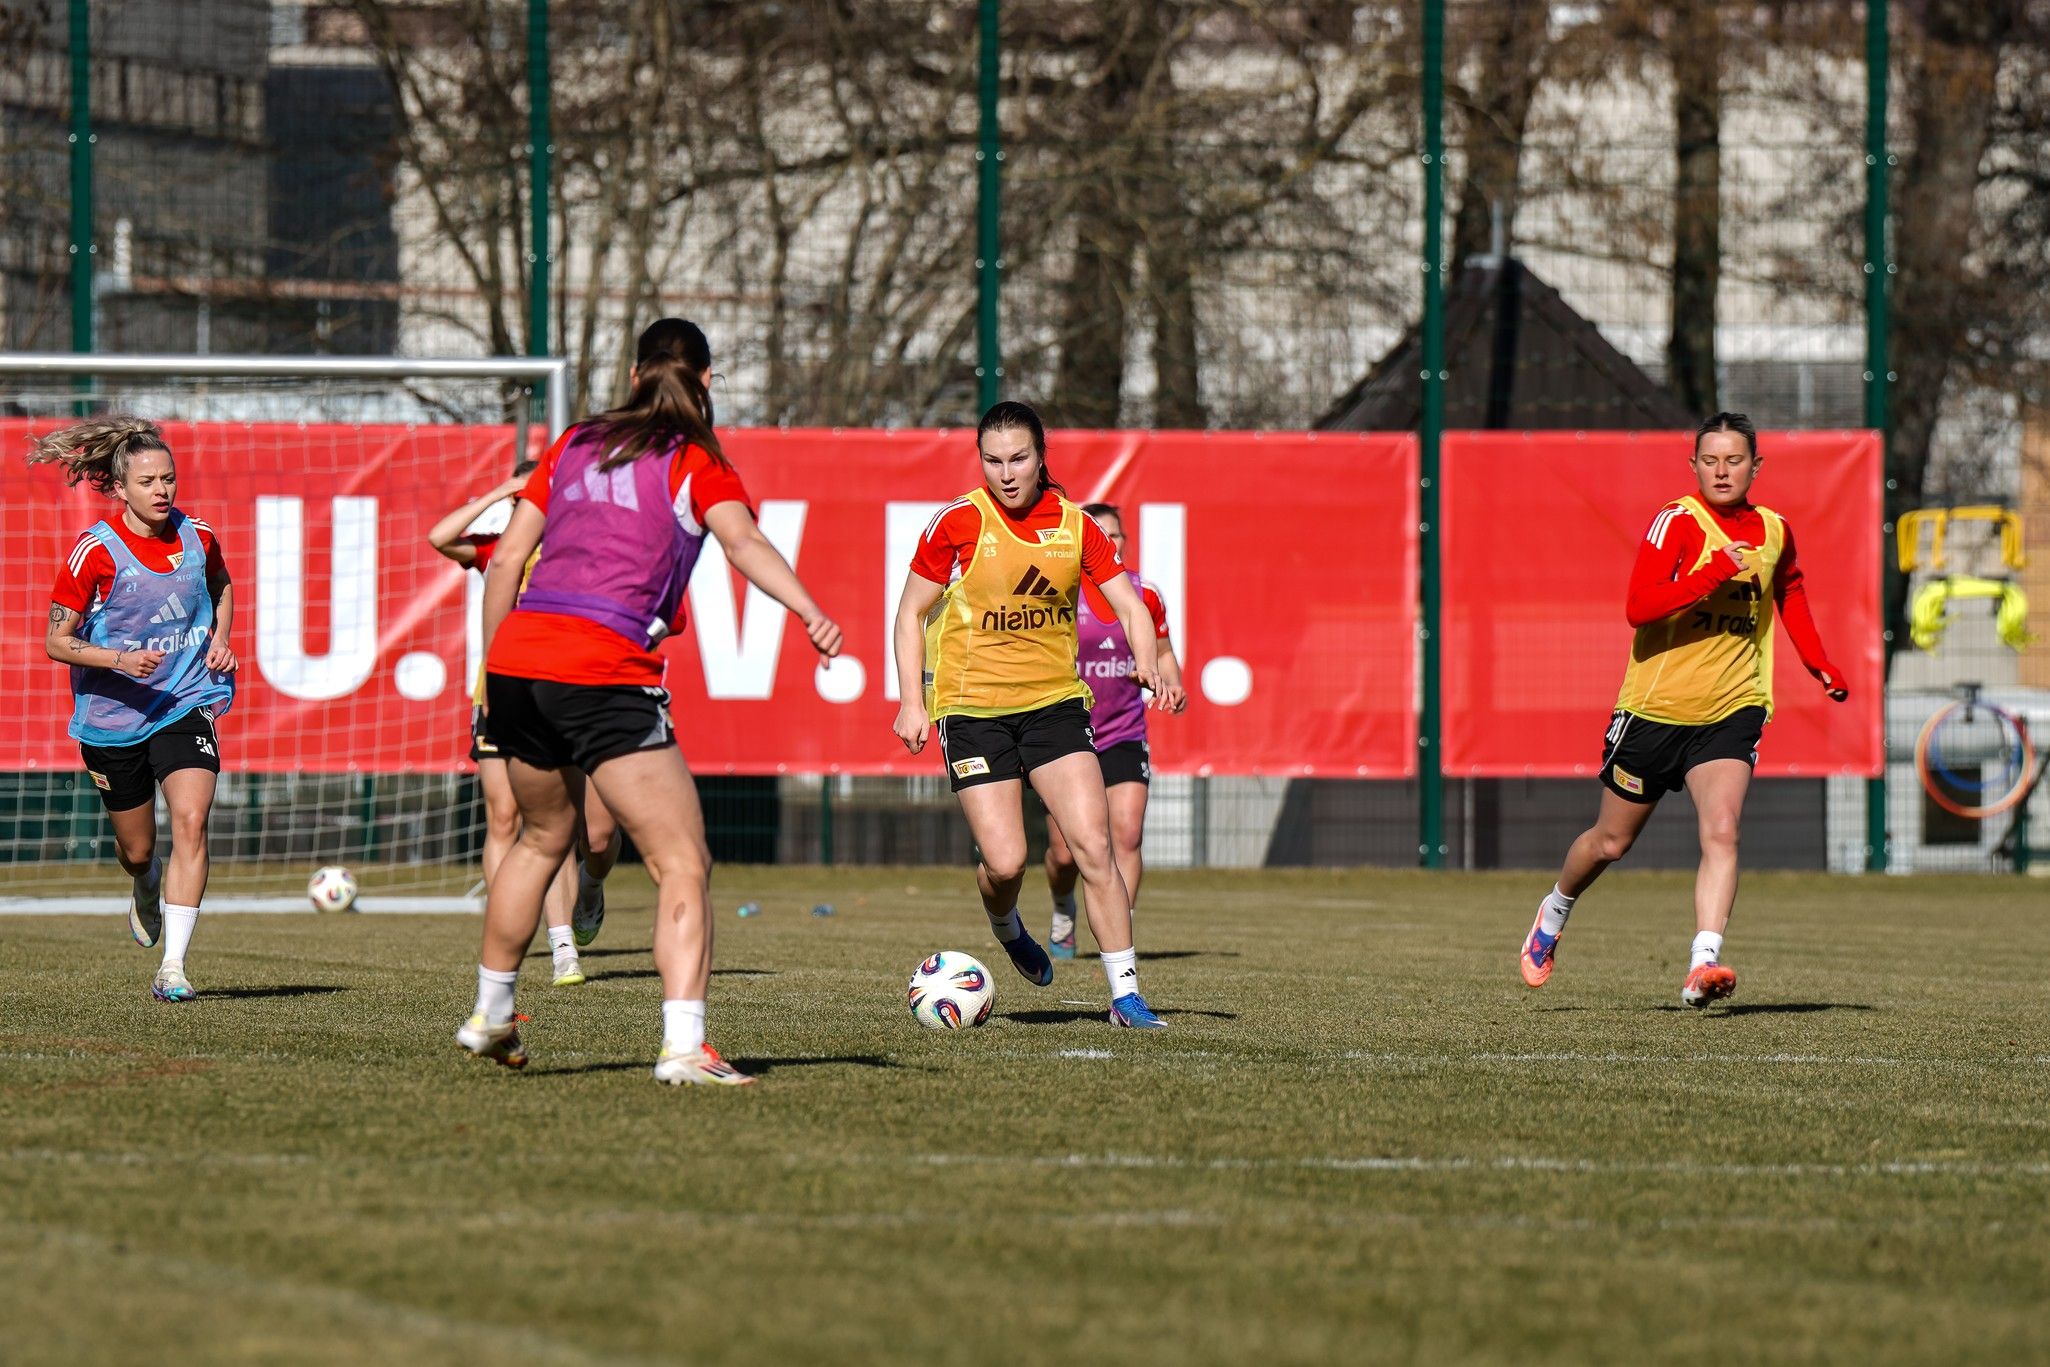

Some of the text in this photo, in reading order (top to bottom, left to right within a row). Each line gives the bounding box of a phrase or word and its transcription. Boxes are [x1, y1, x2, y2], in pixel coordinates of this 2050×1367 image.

[983, 546, 997, 558] 25
[126, 582, 137, 593] 27
[195, 735, 207, 746] 27
